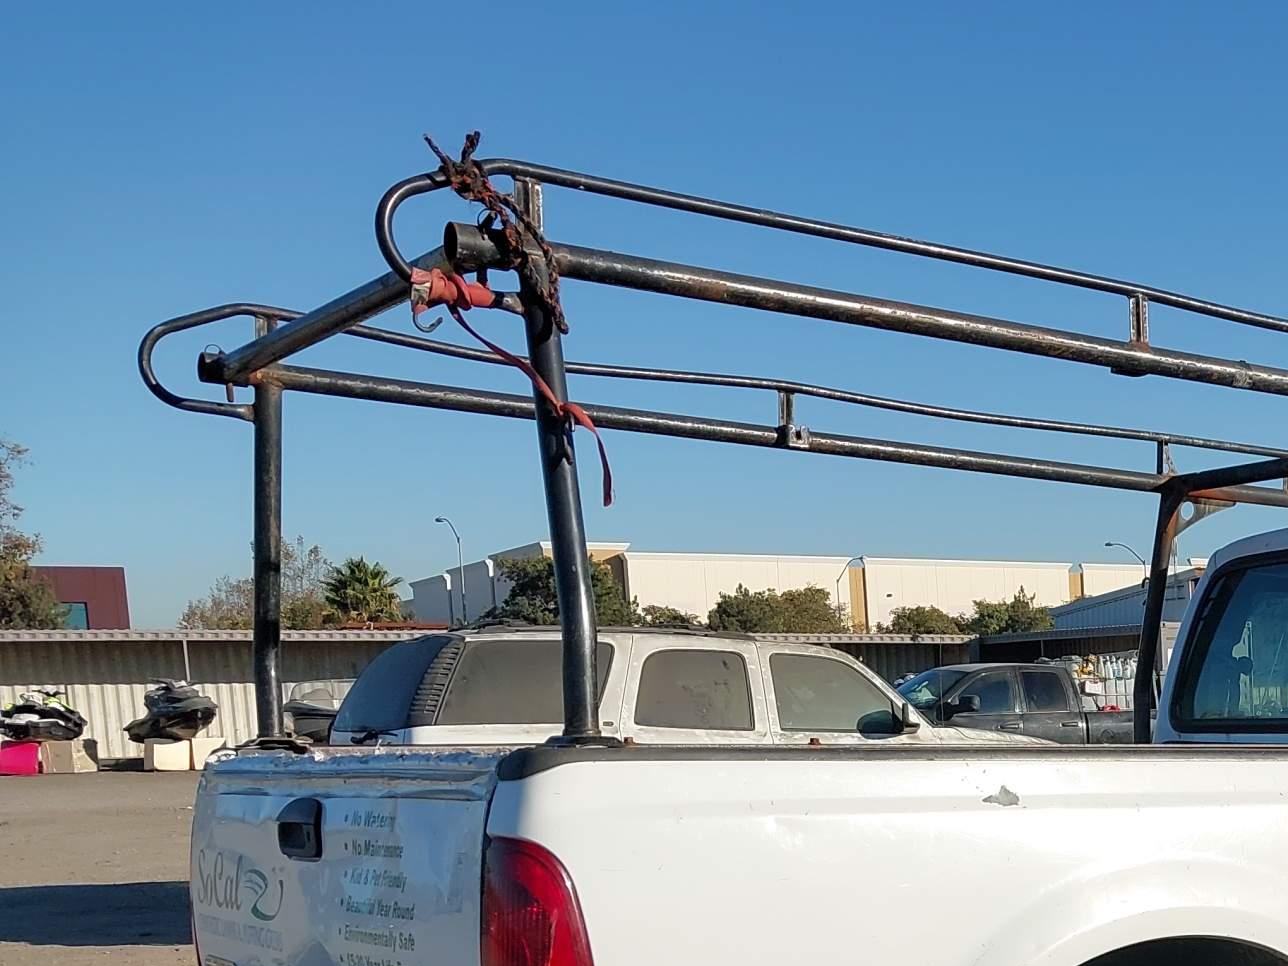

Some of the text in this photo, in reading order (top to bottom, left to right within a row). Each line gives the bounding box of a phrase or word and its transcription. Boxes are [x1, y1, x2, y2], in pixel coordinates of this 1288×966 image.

[351, 809, 361, 826] No
[352, 840, 361, 856] No
[196, 849, 242, 911] SoCal
[376, 899, 391, 917] Year
[399, 931, 415, 951] Safe
